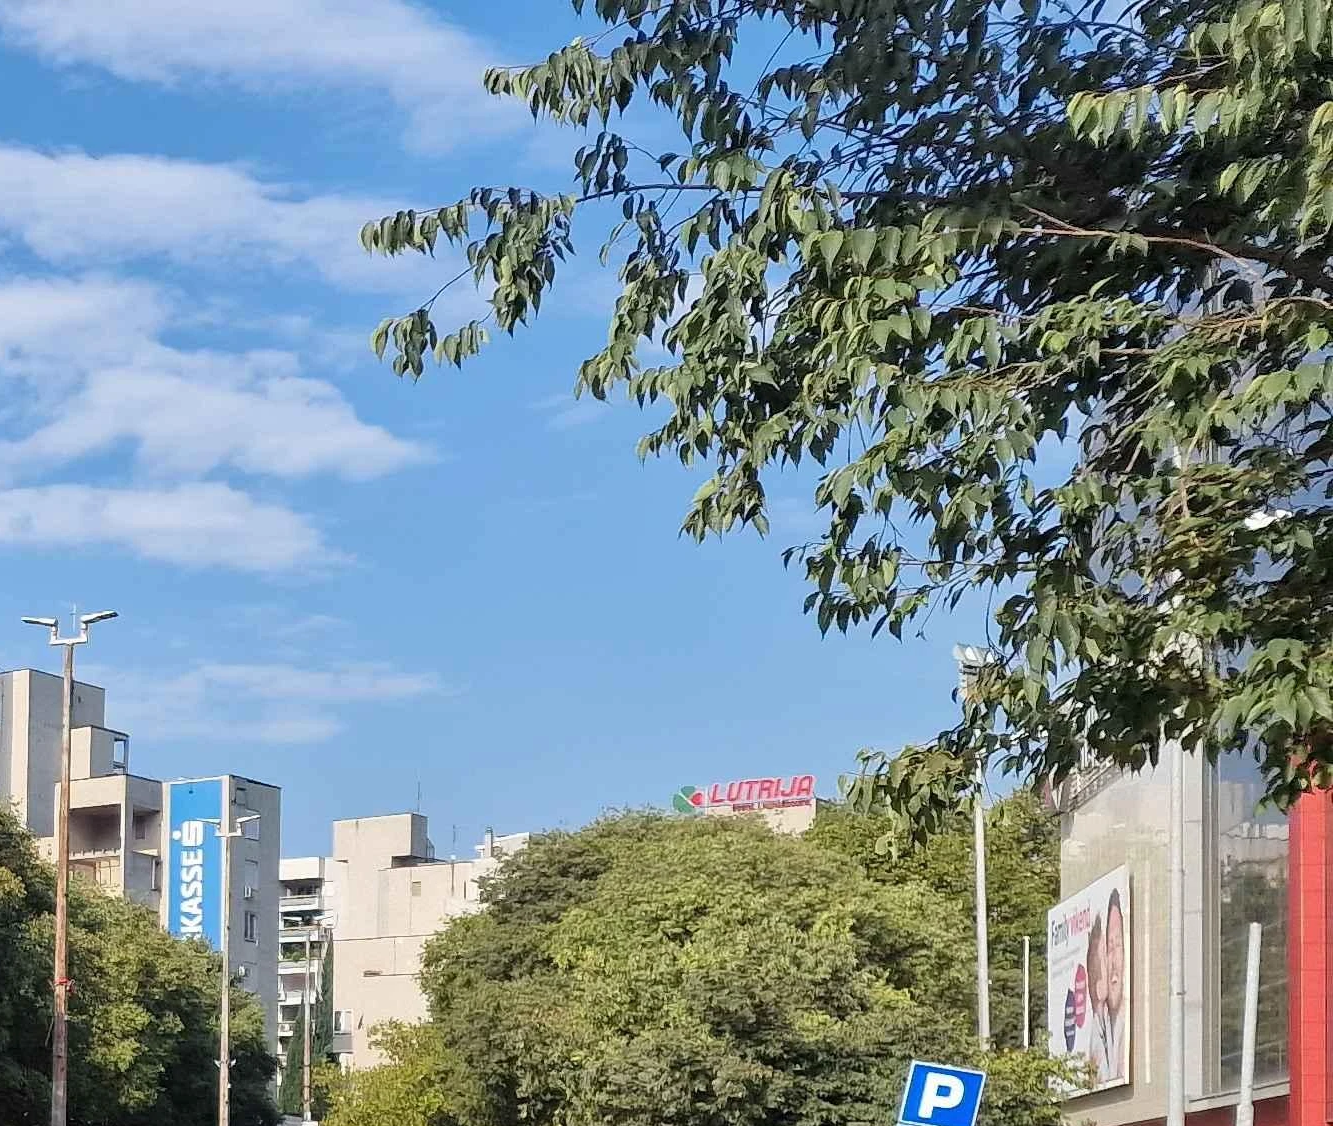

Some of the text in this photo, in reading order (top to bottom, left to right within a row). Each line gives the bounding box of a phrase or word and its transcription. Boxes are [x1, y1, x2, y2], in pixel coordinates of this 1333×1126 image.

[709, 775, 813, 804] LUTRIJA
[181, 847, 203, 941] KASSE
[918, 1072, 964, 1119] P
